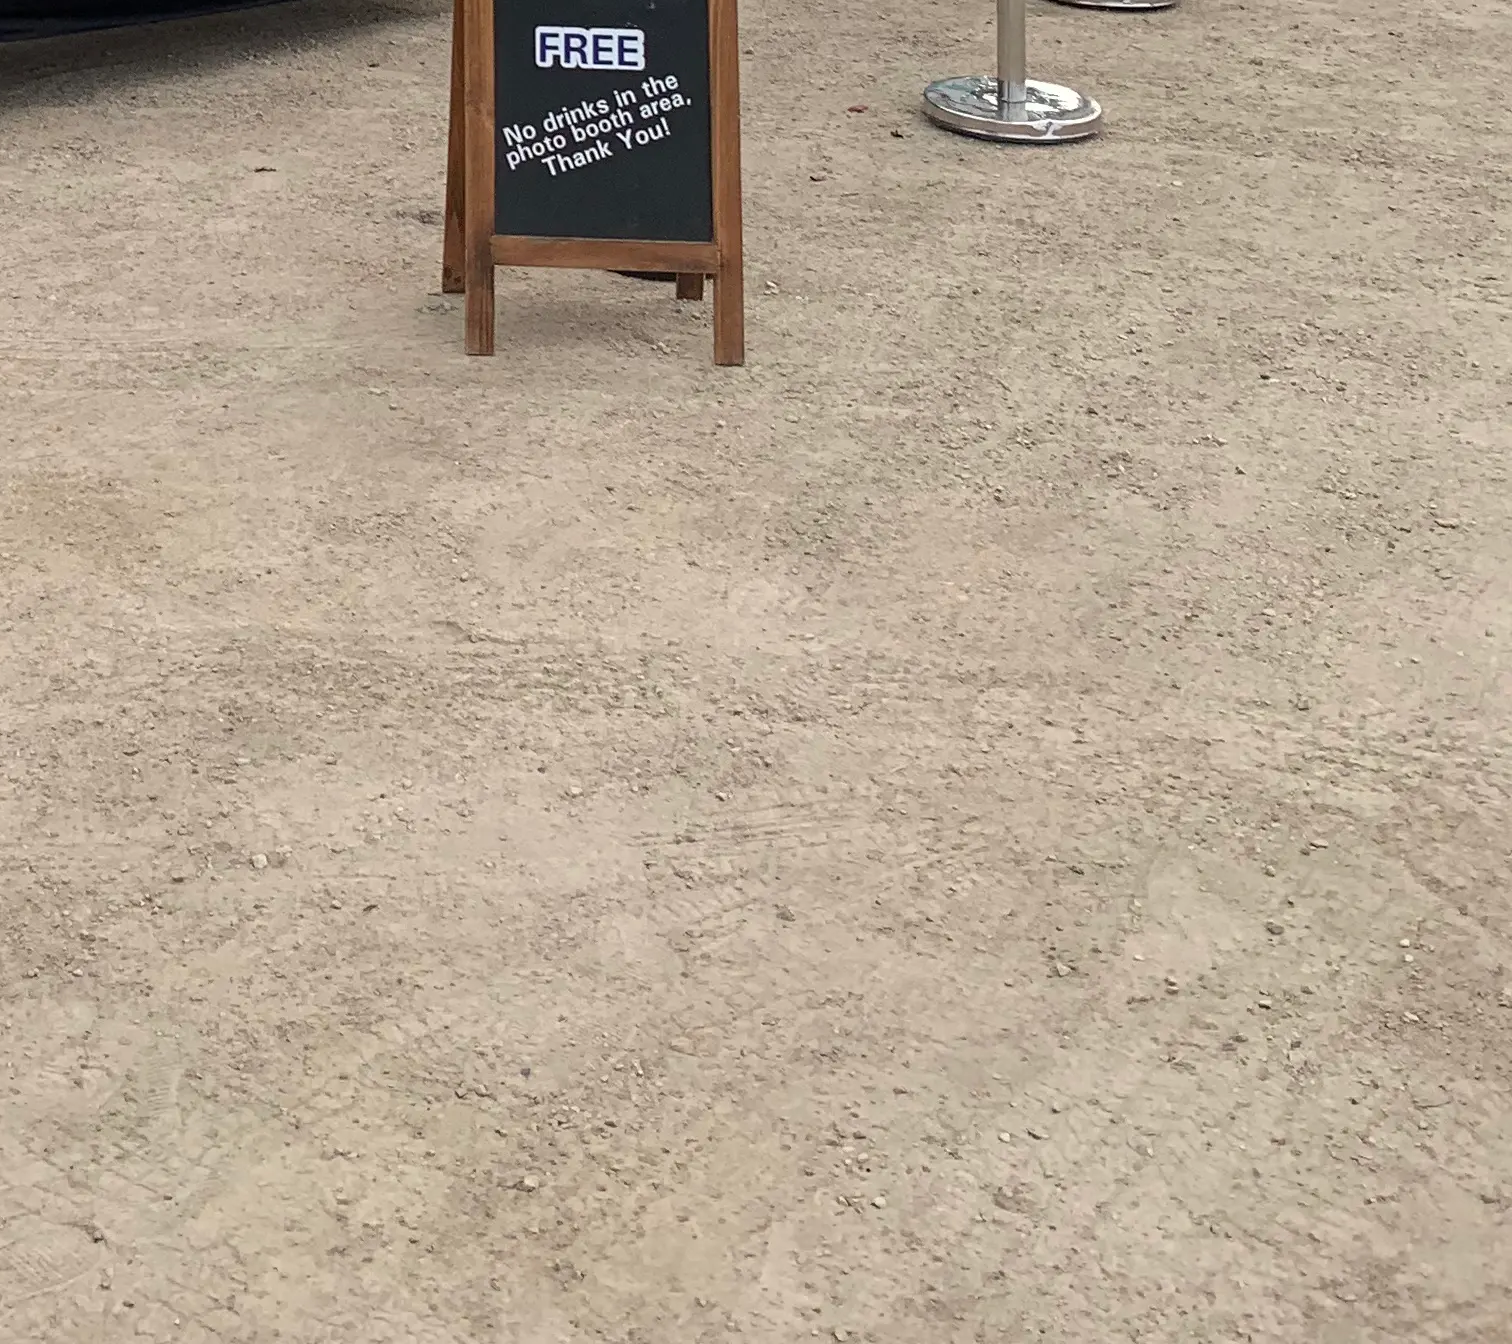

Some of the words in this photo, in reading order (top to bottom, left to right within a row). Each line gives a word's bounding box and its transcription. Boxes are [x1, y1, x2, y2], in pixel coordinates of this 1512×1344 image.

[538, 30, 641, 68] FREE
[502, 124, 536, 147] No
[542, 100, 610, 133] drinks
[613, 89, 637, 108] in
[641, 74, 679, 98] the
[505, 134, 566, 171] photo
[571, 108, 634, 142] booth
[541, 139, 613, 176] Thank
[616, 117, 672, 150] You!
